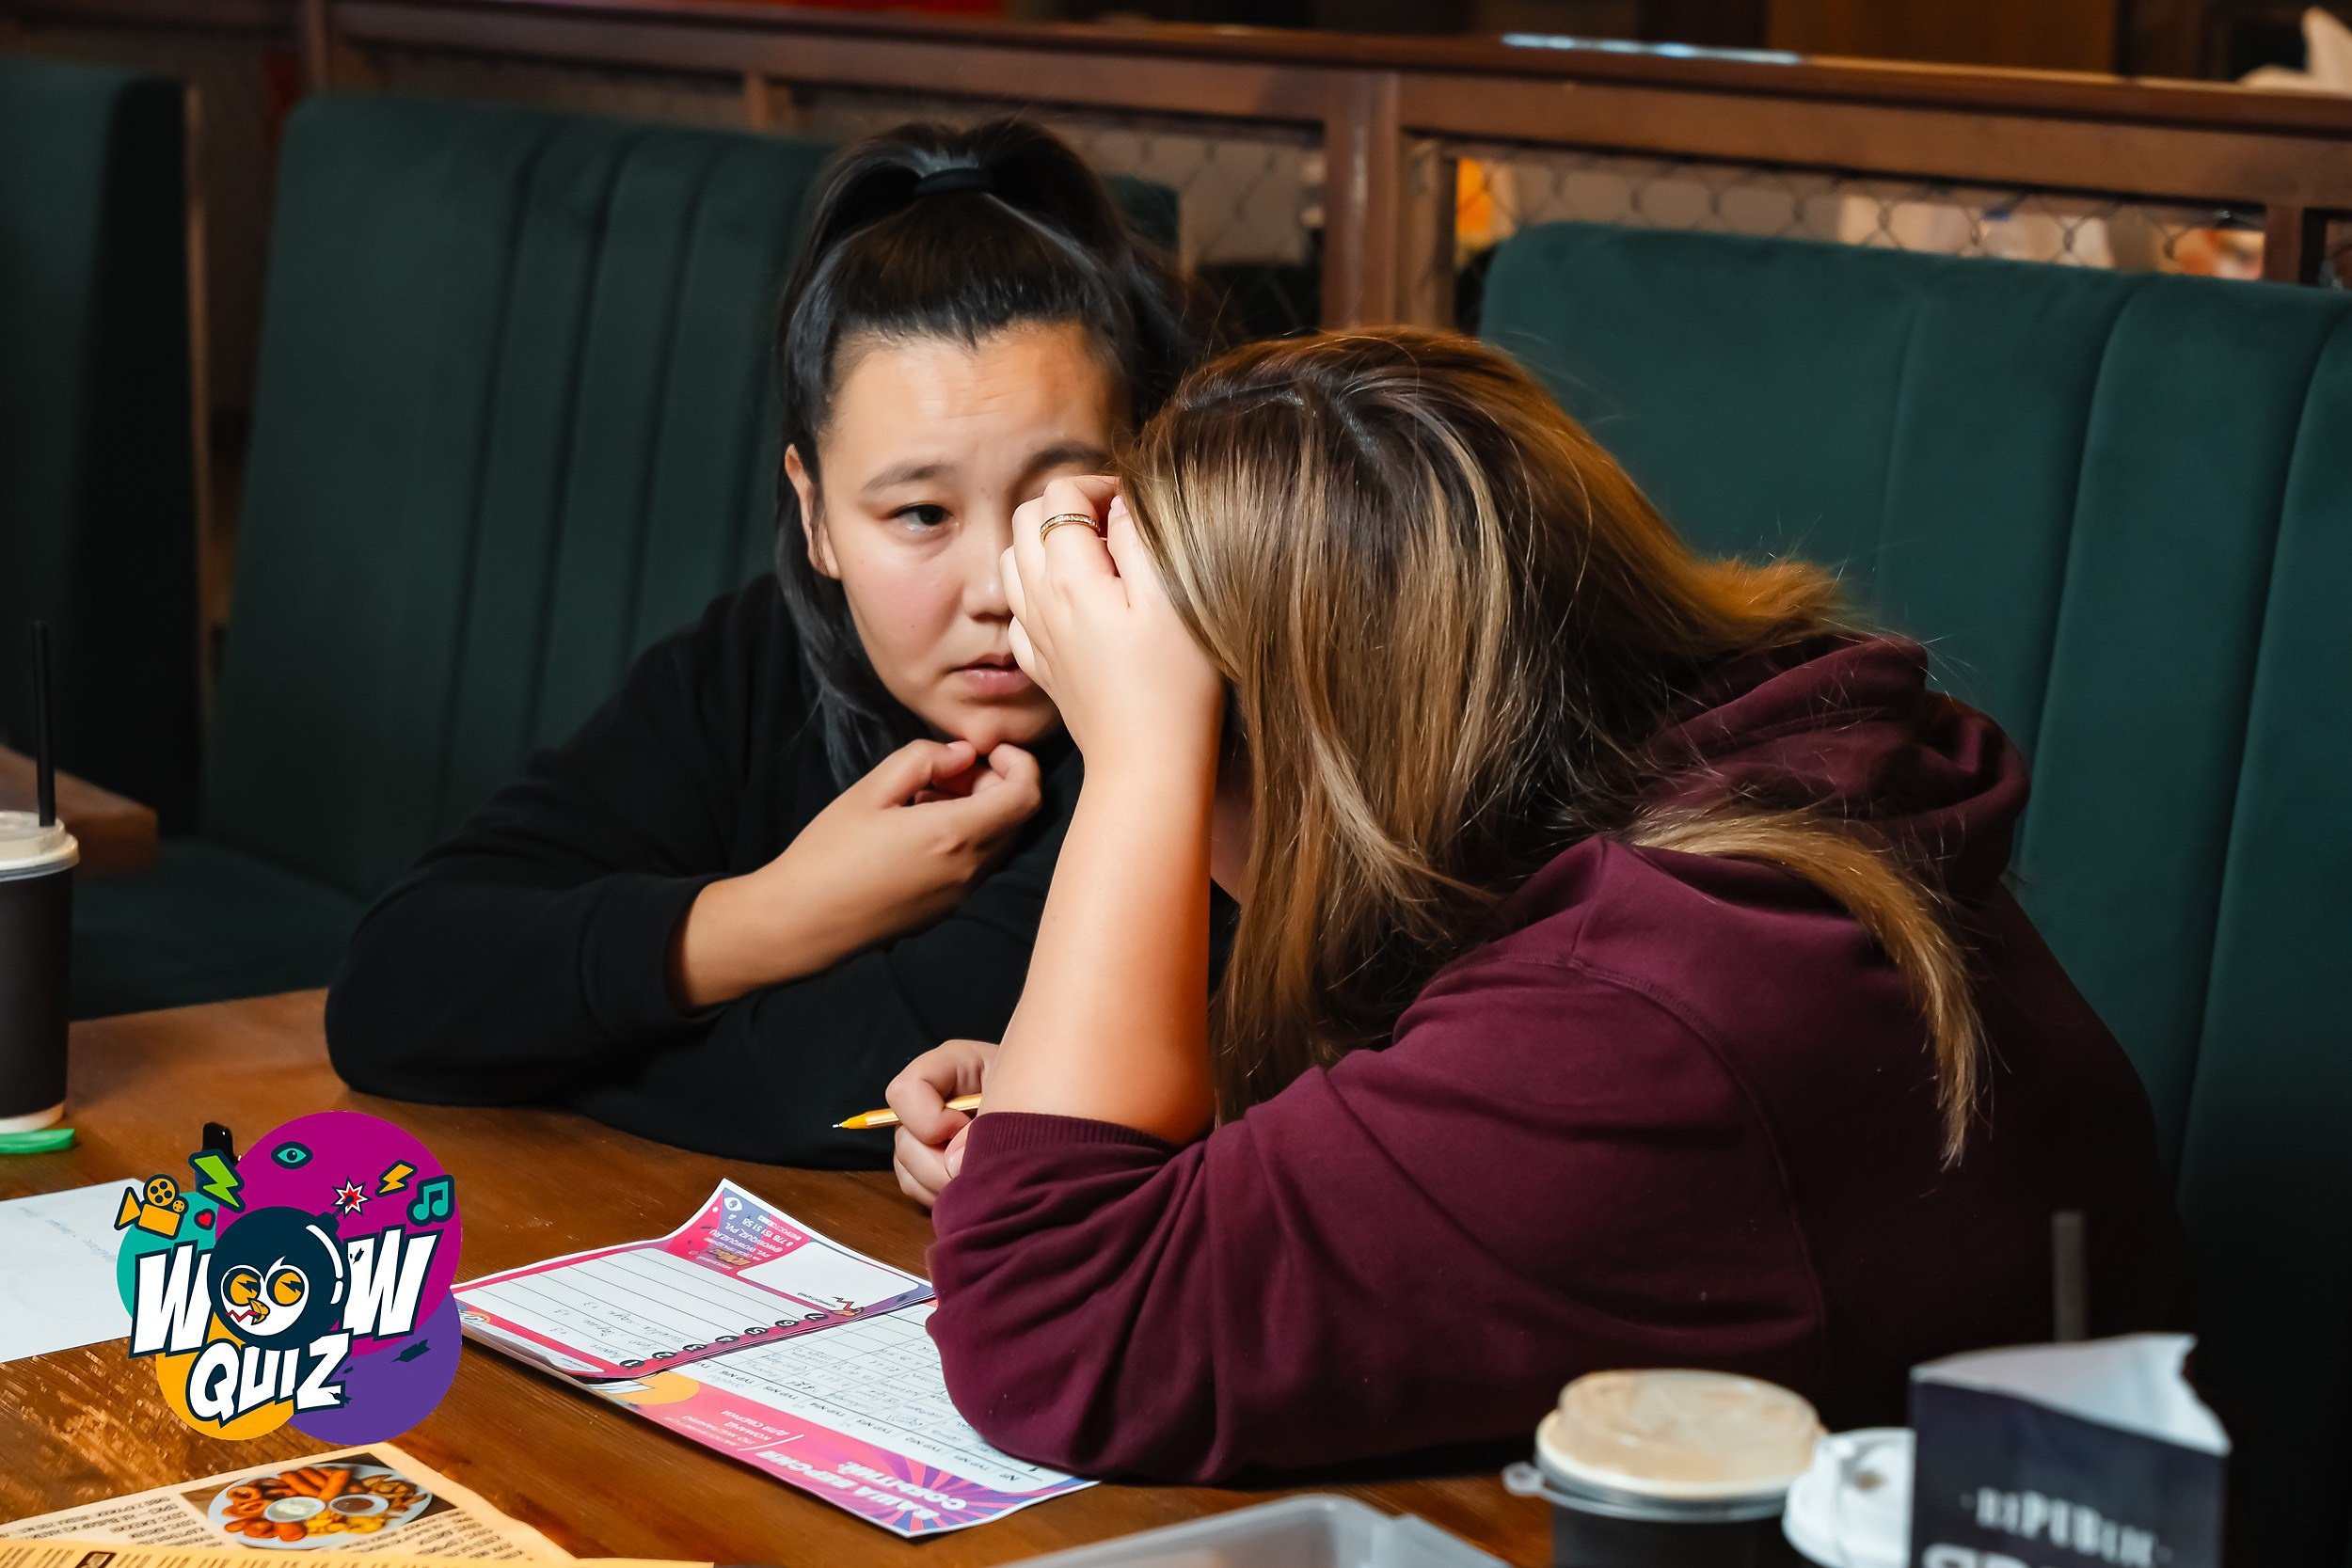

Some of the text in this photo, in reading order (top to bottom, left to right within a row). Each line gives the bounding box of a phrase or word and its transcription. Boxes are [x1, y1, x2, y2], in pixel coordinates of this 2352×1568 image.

[741, 1217, 755, 1227] 58
[761, 1228, 774, 1238] 151
[771, 1234, 787, 1244] 778
[719, 1409, 790, 1436] ДЛЯ СВЕРКИ
[723, 1420, 772, 1442] КОМАНД
